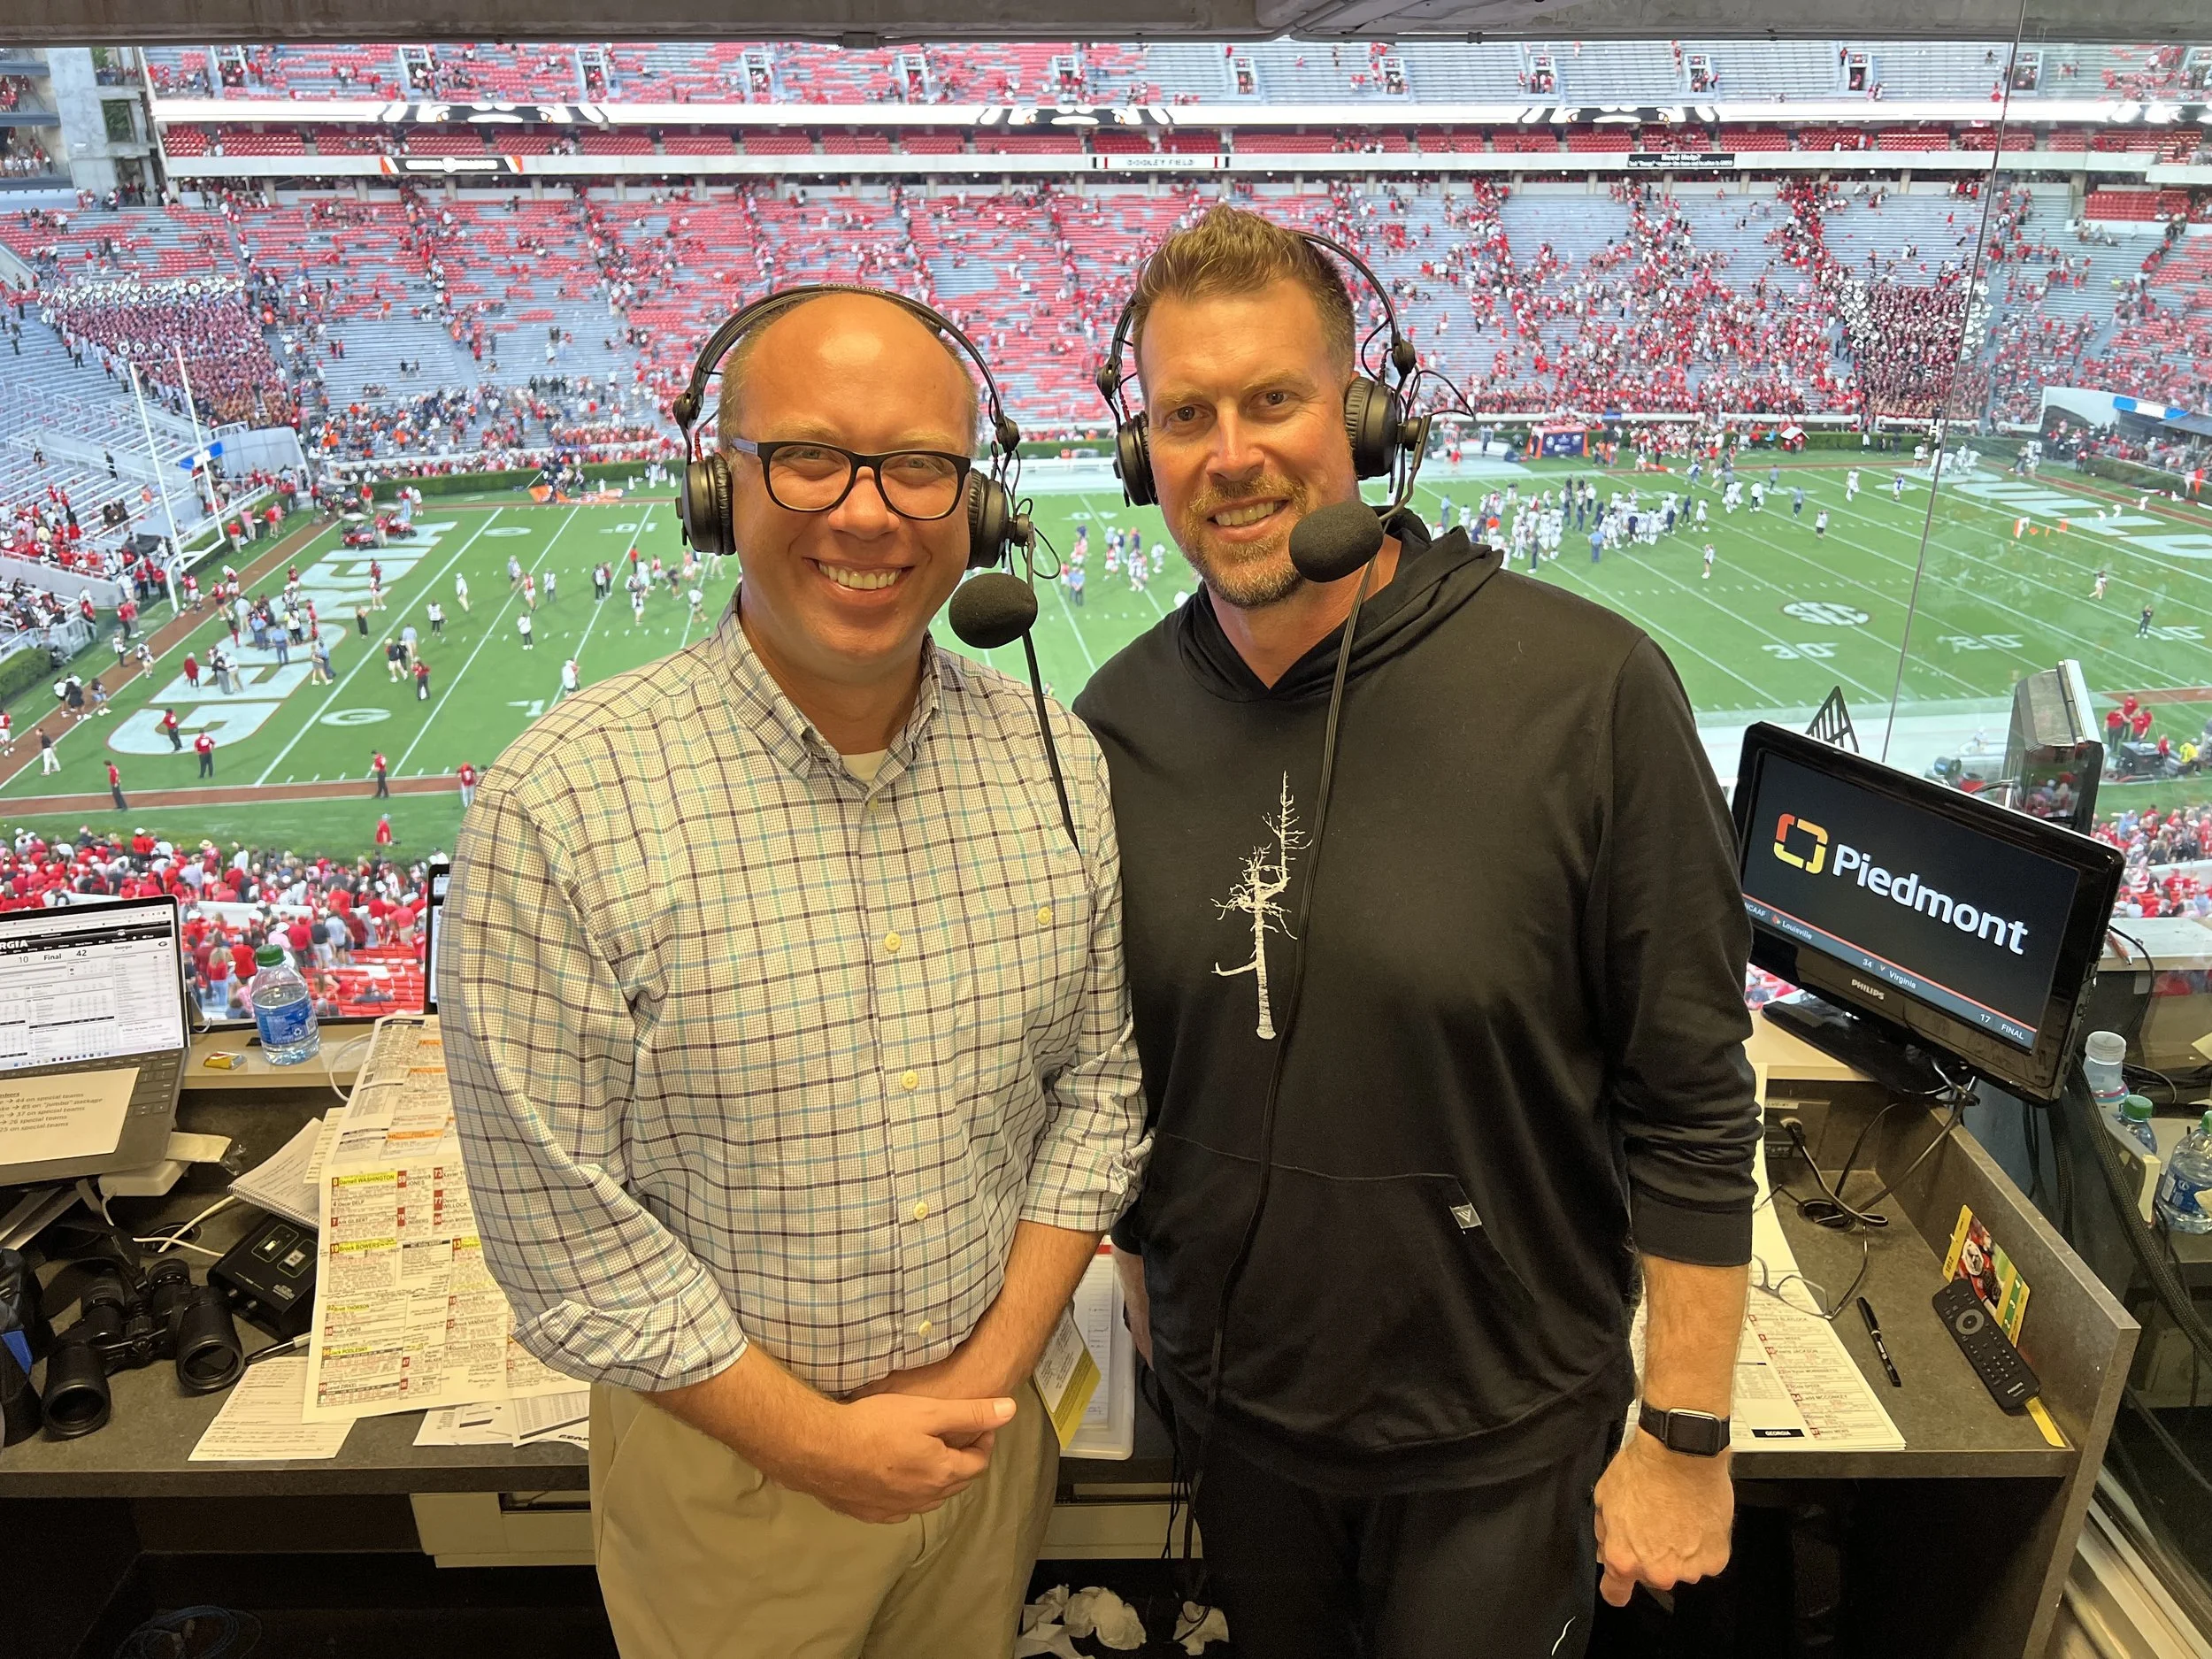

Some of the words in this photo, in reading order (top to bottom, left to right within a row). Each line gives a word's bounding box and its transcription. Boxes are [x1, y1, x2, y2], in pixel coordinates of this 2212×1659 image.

[1832, 843, 2029, 956] Piedmont
[1782, 920, 1813, 940] Louisville
[1863, 958, 1872, 968] 34
[1889, 971, 1916, 989] Virginia
[1980, 1013, 1991, 1023] 17
[2001, 1023, 2024, 1041] FINAL
[1851, 979, 1885, 1000] PHILIPS
